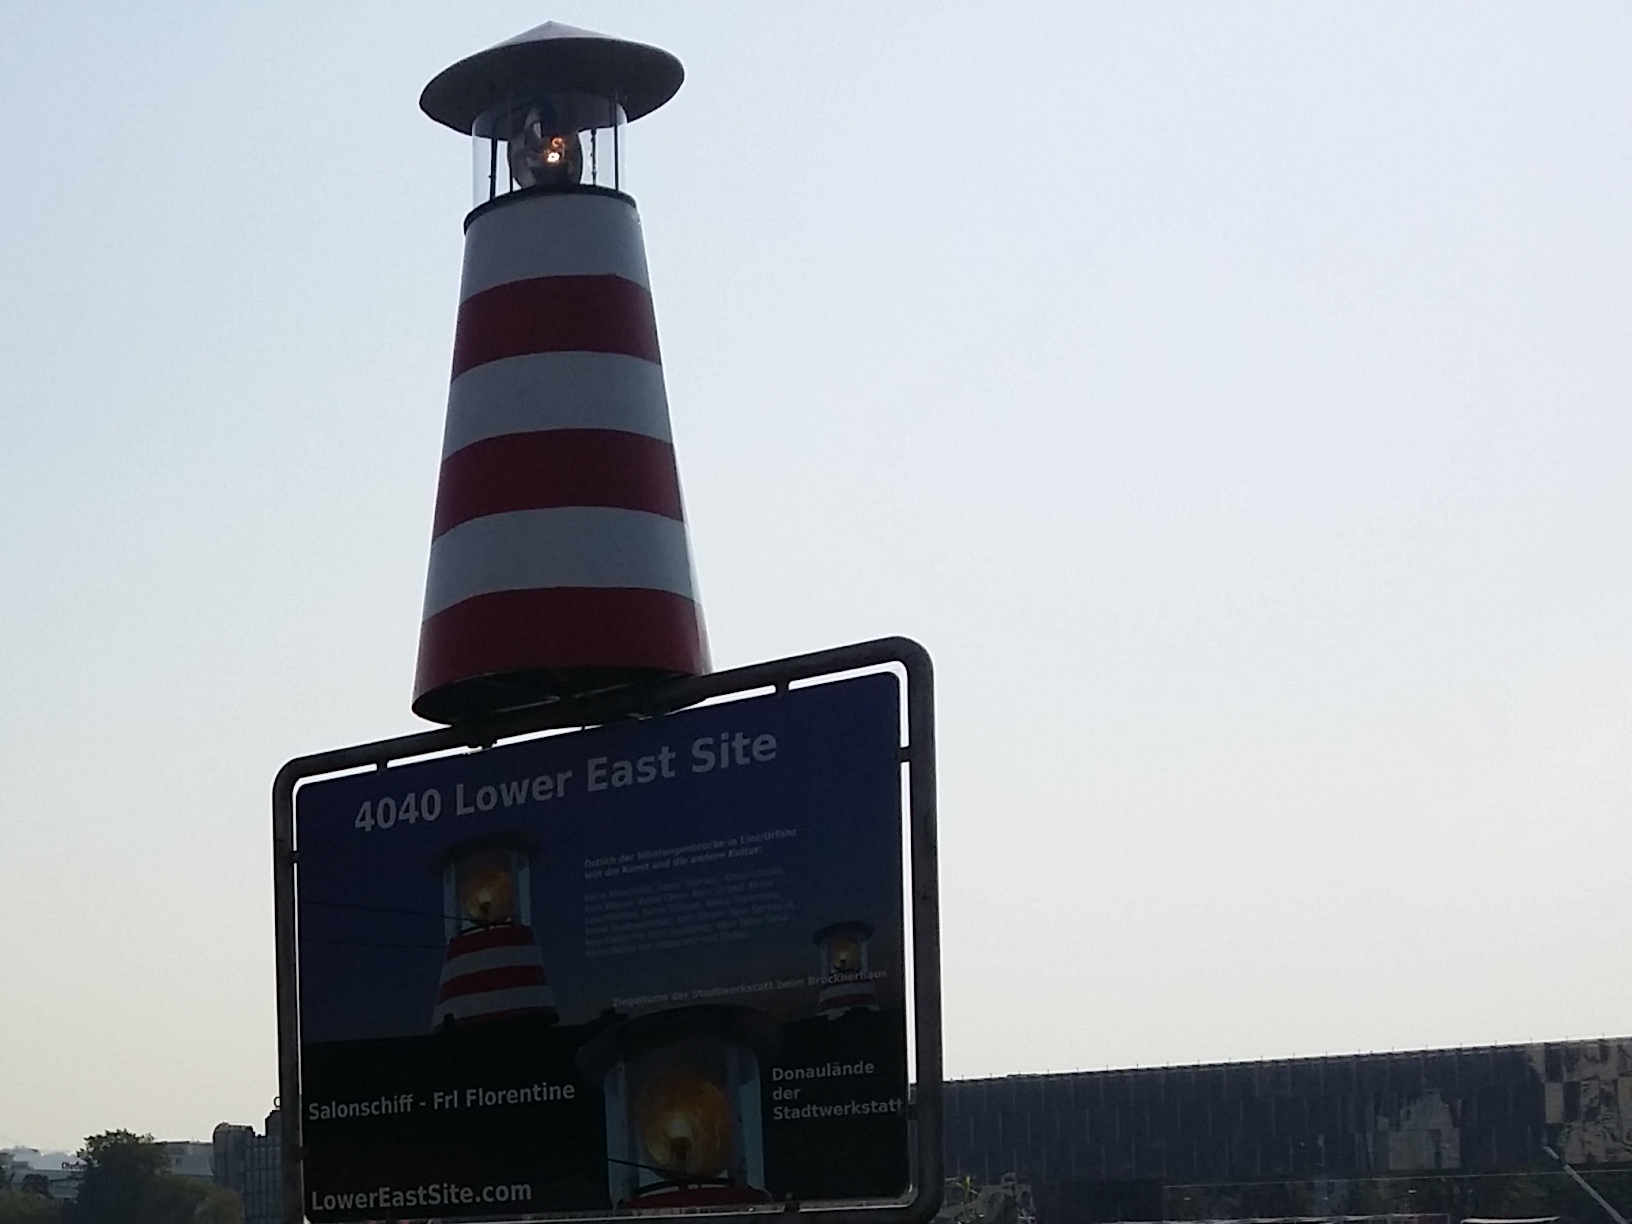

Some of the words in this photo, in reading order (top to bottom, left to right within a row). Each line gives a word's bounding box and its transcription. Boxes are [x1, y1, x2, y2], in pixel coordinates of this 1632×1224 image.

[354, 788, 441, 832] 4040
[456, 769, 573, 816] Lower
[587, 746, 676, 792] East
[691, 732, 778, 774] Site
[671, 990, 688, 1001] der
[776, 979, 804, 990] beim
[772, 1060, 875, 1081] Donaulände
[308, 1093, 415, 1121] Salonschiff
[433, 1090, 458, 1110] Frl
[466, 1081, 576, 1108] Florentine
[772, 1087, 801, 1101] der
[773, 1098, 904, 1121] Stadtwerkstatt
[311, 1182, 532, 1212] LowerEastSite.com
